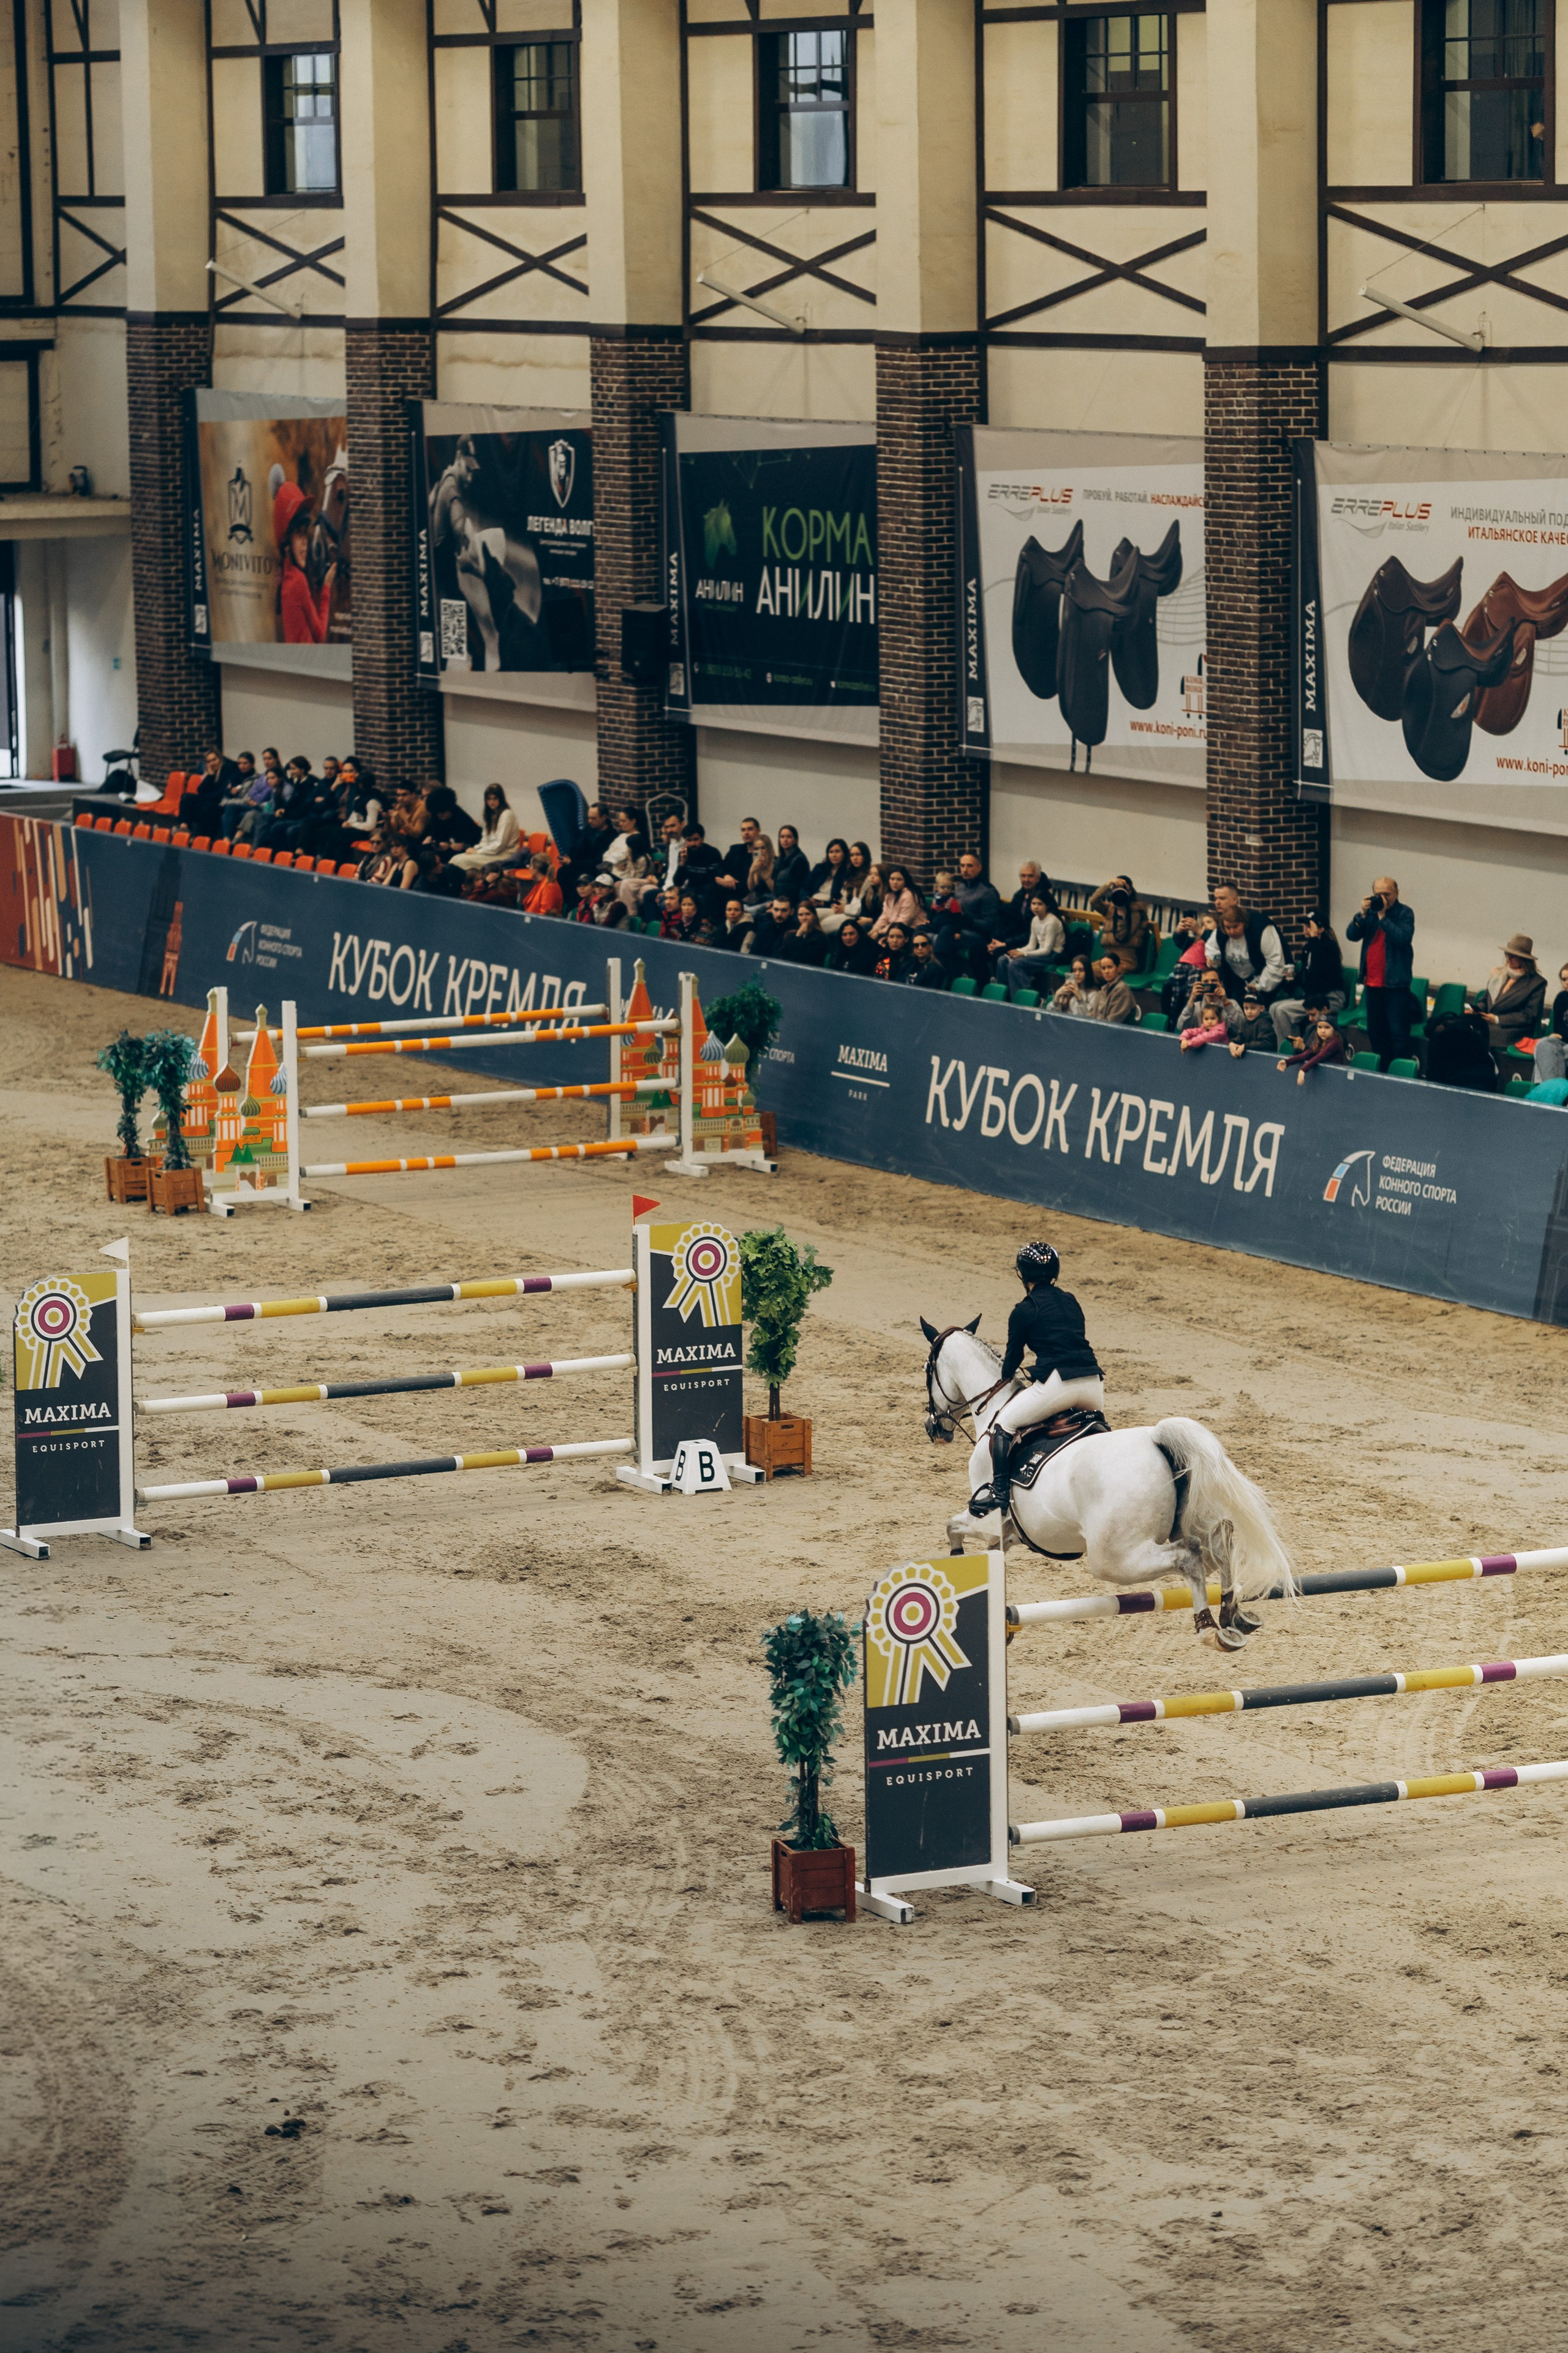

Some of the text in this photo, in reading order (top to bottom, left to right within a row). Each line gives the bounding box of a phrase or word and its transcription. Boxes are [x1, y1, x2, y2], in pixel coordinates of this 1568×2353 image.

[988, 483, 1073, 504] ERREPLUS
[1331, 497, 1432, 519] ERREPLUS
[1451, 506, 1546, 526] ИНДИВИДУАЛЬНЫЙ
[763, 506, 873, 565] КОРМА
[1468, 526, 1568, 545] ИТАЛЬЯНСКОЕ КАЧЕ
[418, 527, 428, 618] MAXIMA
[669, 551, 678, 646] MAXIMA
[756, 565, 875, 625] АНИЛИН
[967, 578, 978, 681] MAXIMA
[1305, 600, 1316, 711] MAXIMA
[328, 931, 587, 1043] КУБОК КРЕМЛЯ
[837, 1044, 888, 1072] MAXIMA
[925, 1055, 1285, 1198] КУБОК КРЕМЛЯ
[1382, 1154, 1436, 1178] ФЕДЕРАЦИЯ
[1379, 1175, 1457, 1204] КОННОГО СПОРТА
[1375, 1195, 1412, 1216] РОССИИ
[657, 1342, 736, 1365] MAXIMA
[663, 1378, 730, 1391] EQUISPORT
[24, 1402, 111, 1424] MAXIMA
[32, 1440, 105, 1453] EQUISPORT
[675, 1449, 686, 1481] B
[698, 1451, 715, 1482] B
[877, 1719, 981, 1750] MAXIMA
[886, 1767, 974, 1786] EQUISPORT
